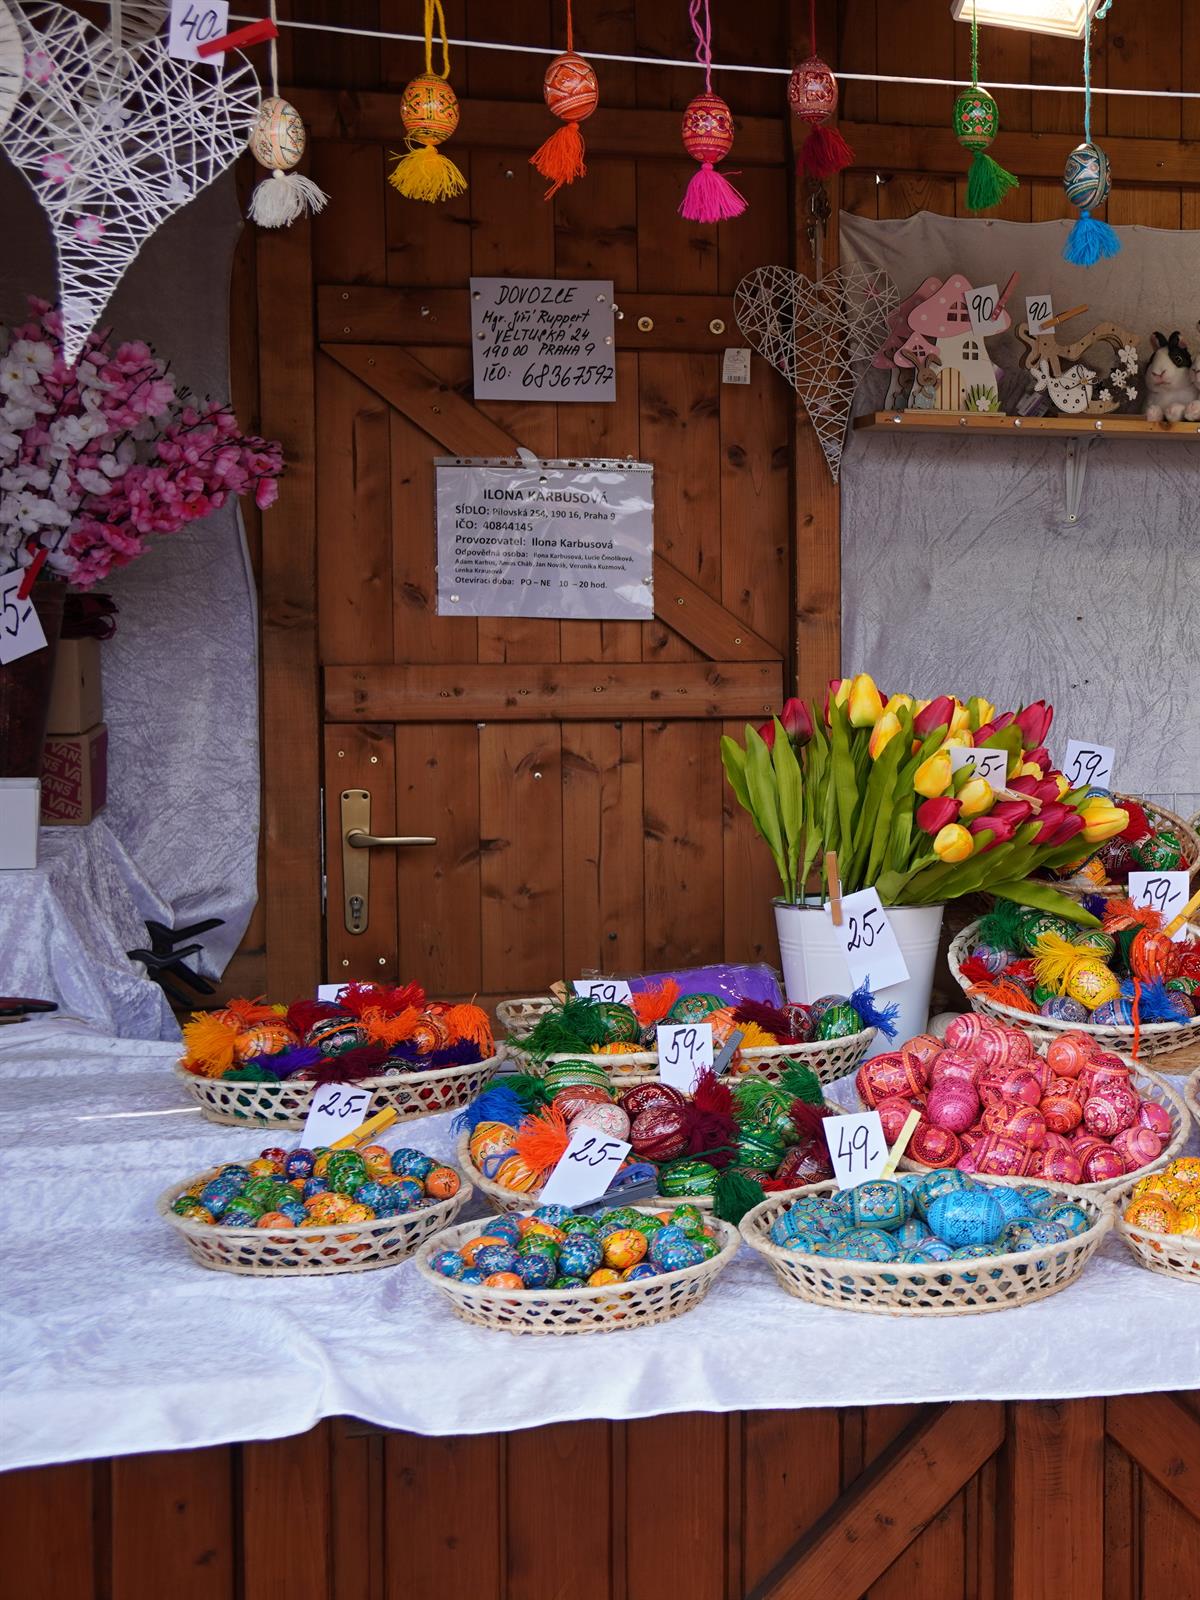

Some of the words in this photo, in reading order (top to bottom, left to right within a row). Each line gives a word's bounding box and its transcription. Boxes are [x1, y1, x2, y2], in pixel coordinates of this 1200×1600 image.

[494, 285, 578, 305] DOVOZCE
[481, 310, 506, 332] Mgr.
[537, 308, 590, 328] Ruppert
[570, 328, 590, 341] 24
[538, 342, 580, 356] PRAHA
[585, 342, 596, 356] 9
[482, 362, 512, 382] IČO:
[522, 362, 614, 388] 68367597
[483, 489, 524, 501] ILONA
[528, 490, 608, 504] KARBUSOVÁ
[455, 503, 490, 515] SÍDLO:
[492, 507, 527, 517] Pilovská
[551, 510, 566, 519] 190
[569, 511, 581, 519] 16,
[583, 511, 608, 520] Praha
[609, 512, 616, 520] 9
[455, 518, 478, 530] IČO:
[482, 521, 533, 532] 40844145
[455, 534, 526, 547] Provozovatel:
[532, 537, 557, 547] Ilona
[560, 537, 613, 549] Karbusová
[455, 548, 500, 557] Odpovědná
[502, 550, 528, 558] osoba:
[550, 552, 583, 560] Karbusová,
[455, 576, 490, 584] Otevírací
[492, 577, 514, 585] doba:
[520, 578, 532, 586] PO
[559, 580, 568, 588] 10
[590, 581, 608, 589] hod.
